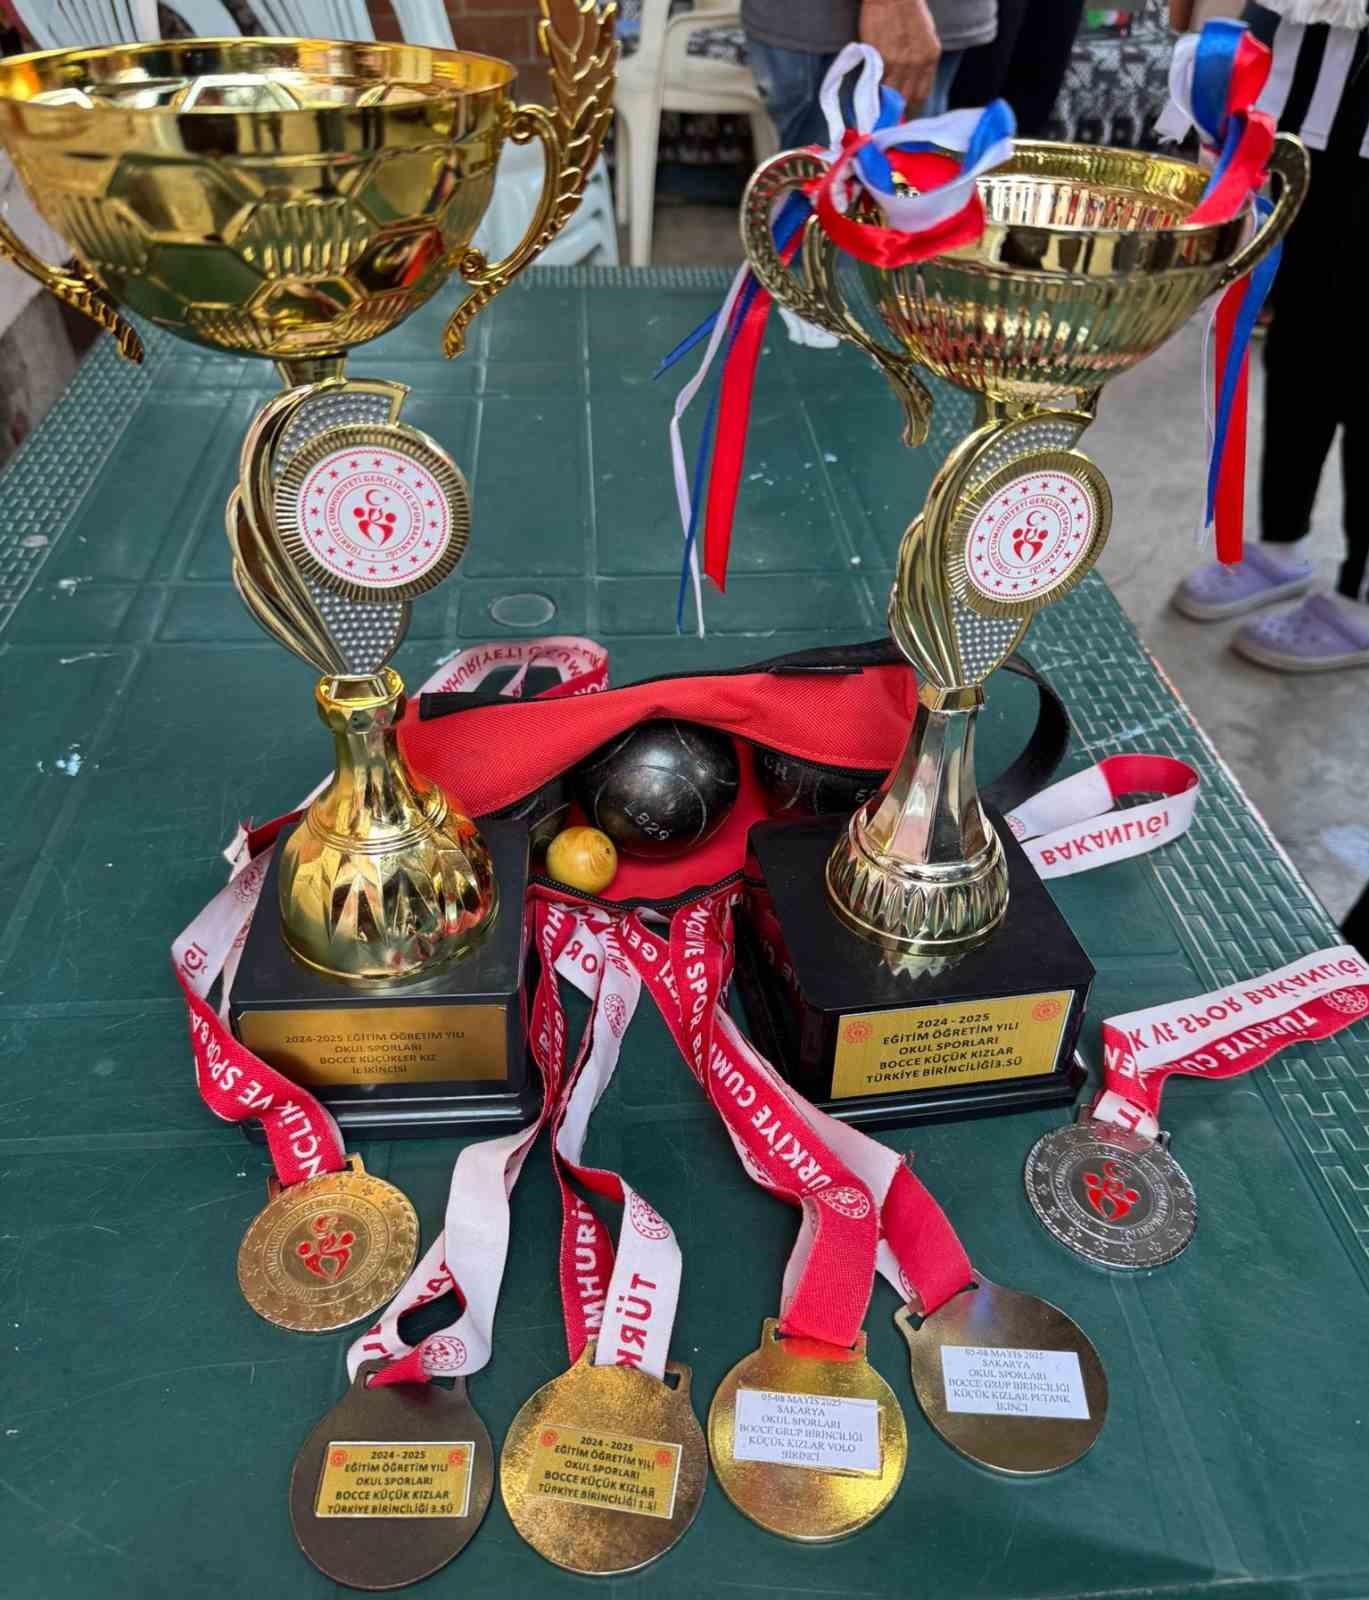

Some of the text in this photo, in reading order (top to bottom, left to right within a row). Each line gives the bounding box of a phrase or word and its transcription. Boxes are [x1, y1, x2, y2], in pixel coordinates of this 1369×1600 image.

[686, 962, 708, 1031] SPOR
[917, 1019, 948, 1029] 2024
[959, 1013, 991, 1024] 2025
[882, 1032, 929, 1045] EĞİTİM
[932, 1024, 993, 1039] ÖĞRETİM
[1215, 1009, 1318, 1061] TÜRKİYE
[335, 1045, 363, 1053] OKUL
[899, 1036, 999, 1055] OKUL SPORLARI
[320, 1057, 357, 1065] BOCCE
[879, 1046, 1014, 1070] BOCCE KÜÇÜK KIZLAR
[867, 1069, 920, 1083] TÜRKİYE
[237, 1080, 274, 1110] VE
[751, 1104, 832, 1194] ÜRKİYE
[982, 1359, 1031, 1369] SAKARYA
[968, 1369, 1047, 1381] OKUL SPORLARI
[776, 1405, 825, 1416] SAKARYA
[761, 1415, 841, 1429] OKUL SPORLARI
[581, 1436, 603, 1446] 2024
[611, 1440, 634, 1452] 2025
[787, 1439, 825, 1450] KIZLAR
[827, 1443, 856, 1453] VOLO
[371, 1451, 394, 1460] 2024
[401, 1450, 427, 1460] 2025
[555, 1445, 588, 1457] EĞİTİM
[590, 1448, 636, 1465] ÖĞRETİM
[345, 1462, 380, 1472] EĞİTİM
[382, 1462, 429, 1472] ÖĞRETİM
[564, 1460, 641, 1479] OKUL SPORLARI
[356, 1477, 433, 1486] OKUL SPORLARI
[544, 1470, 656, 1498] BOCCE KÜÇÜK KIZLAR
[336, 1489, 450, 1501] BOCCE KÜÇÜK KIZLAR
[538, 1483, 579, 1496] TÜRKİYE
[328, 1503, 369, 1514] TÜRKİYE
